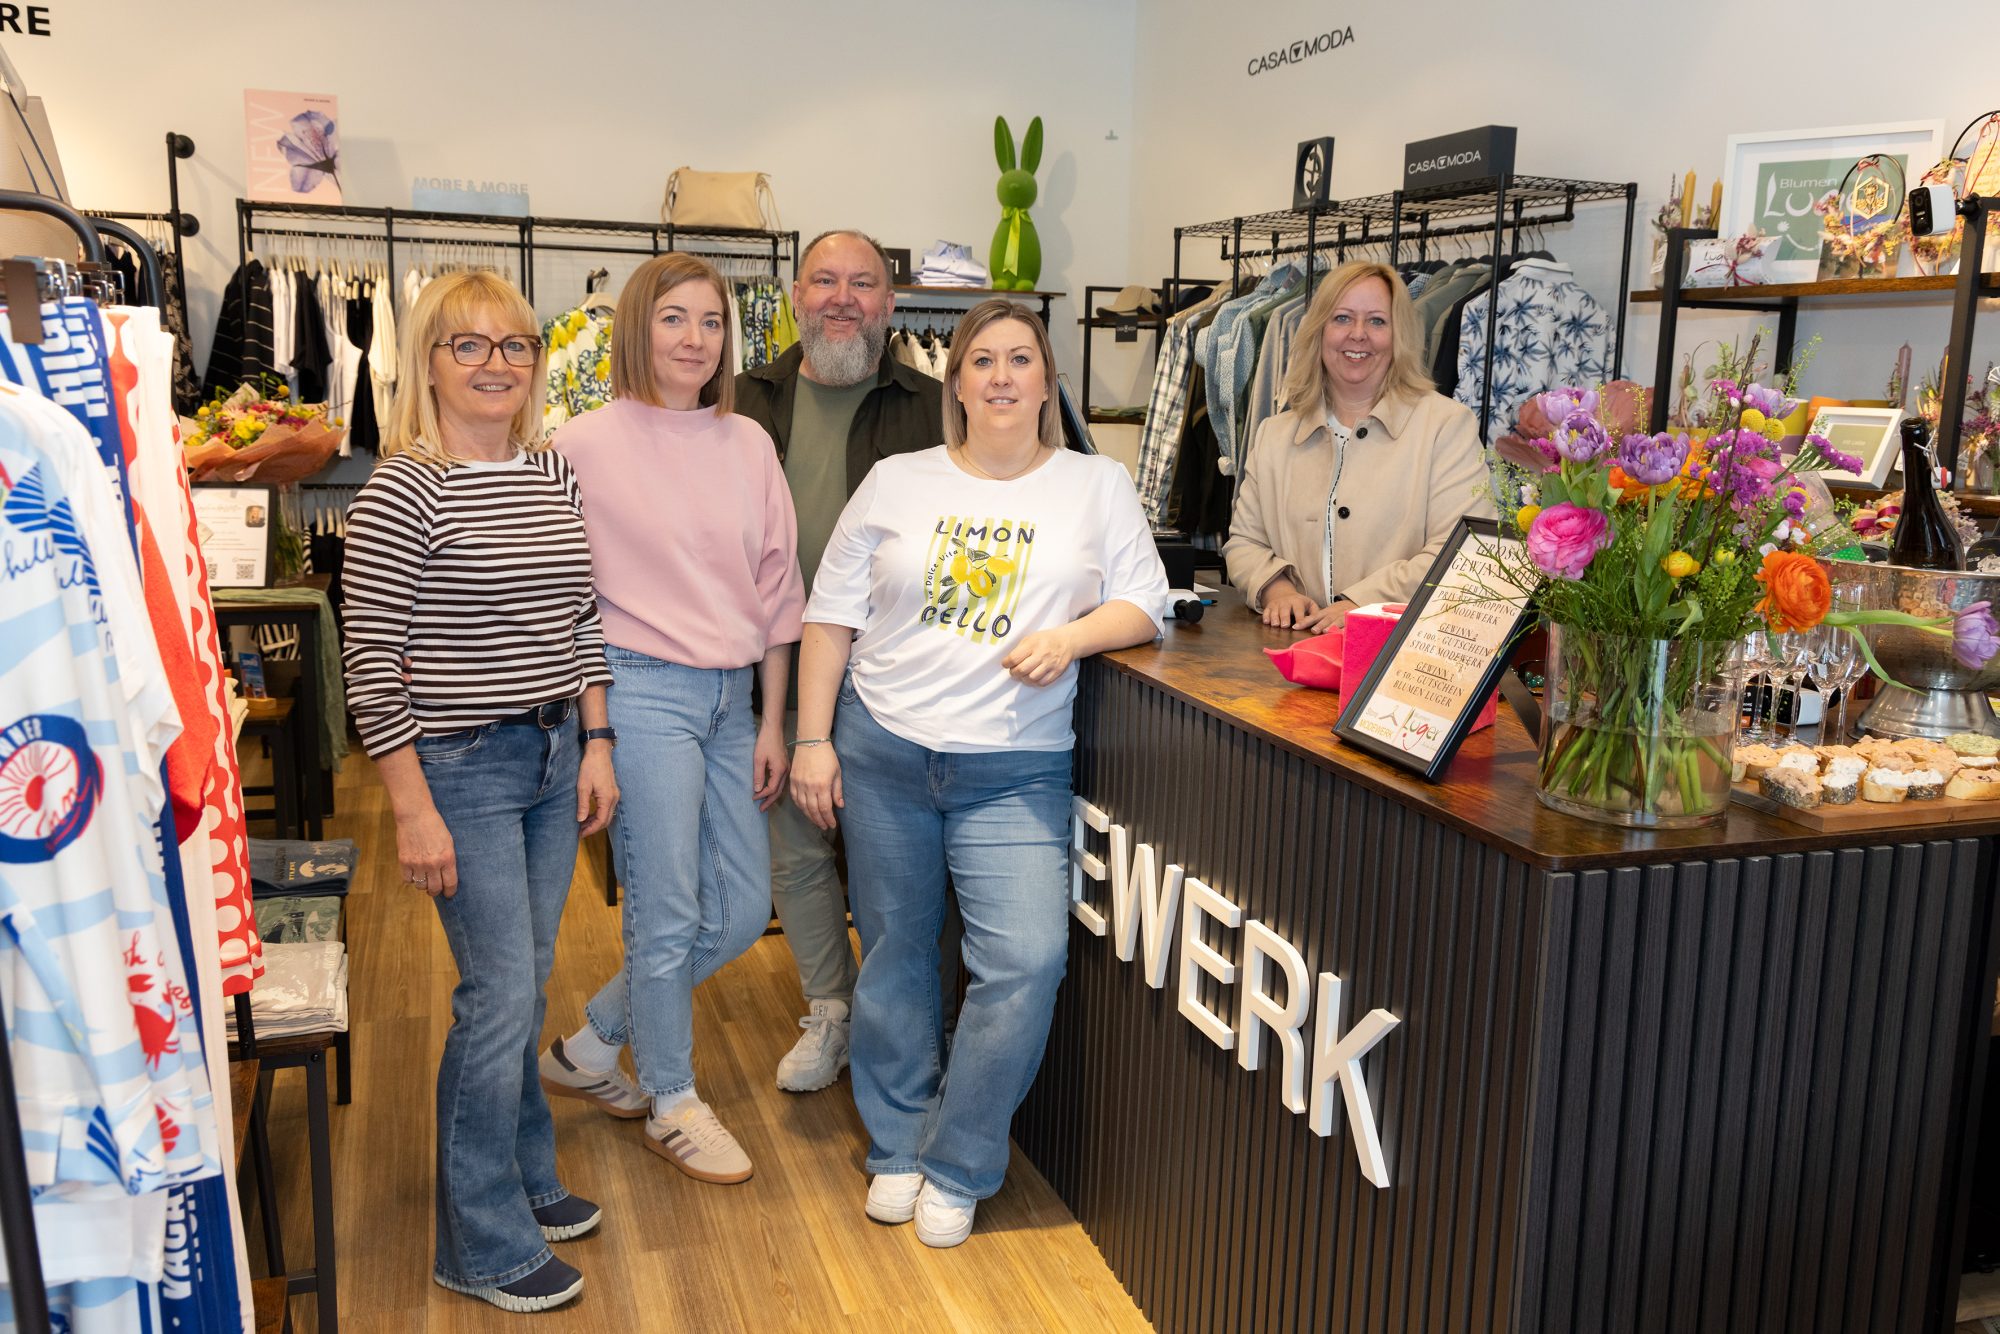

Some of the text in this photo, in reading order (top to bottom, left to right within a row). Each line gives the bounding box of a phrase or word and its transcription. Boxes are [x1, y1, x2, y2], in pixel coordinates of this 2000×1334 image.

[414, 176, 462, 193] MORE
[481, 181, 529, 197] MORE
[1779, 176, 1838, 189] Blumen
[935, 520, 1035, 544] LIMON
[926, 563, 939, 586] Dolce
[939, 549, 959, 562] Vita
[1452, 607, 1501, 626] MODEWERK
[1472, 600, 1517, 617] SHOPPING
[921, 605, 1012, 638] CELLO
[1440, 622, 1472, 638] GEWINN
[1410, 639, 1485, 669] STORE MODEWERK
[1442, 636, 1491, 657] GUTSCHEIN
[1416, 661, 1448, 678] GEWINN
[1393, 679, 1453, 708] BLUMEN LUGER
[1416, 675, 1465, 697] GUTSCHEIN
[1401, 707, 1442, 751] Luger
[1067, 795, 1401, 1189] EWERK
